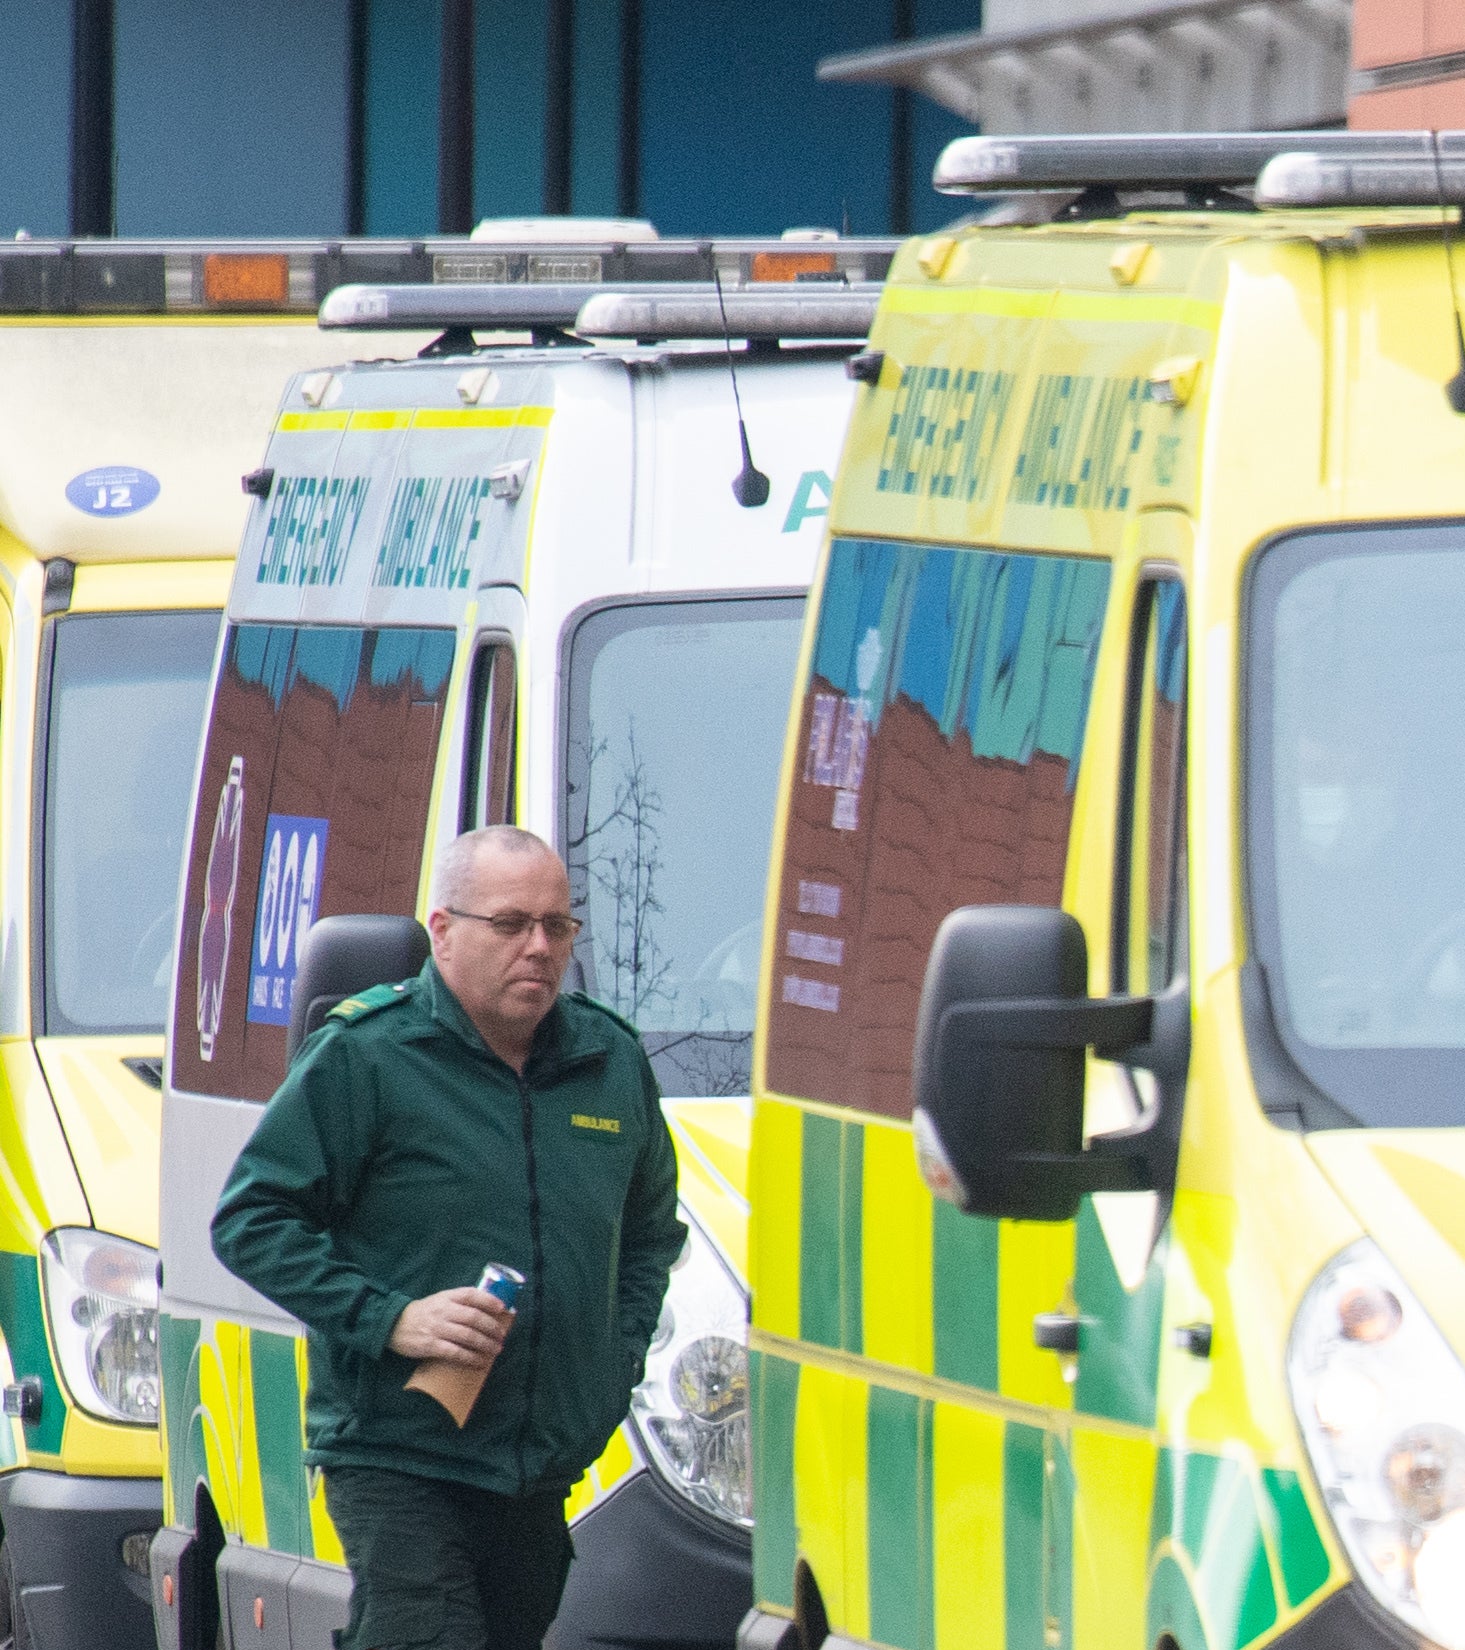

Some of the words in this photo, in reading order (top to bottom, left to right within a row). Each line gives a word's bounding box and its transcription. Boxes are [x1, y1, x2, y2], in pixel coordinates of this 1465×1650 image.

[92, 485, 132, 509] J2
[256, 476, 371, 587] EMERGENCY
[371, 476, 491, 590] AMBULANCE
